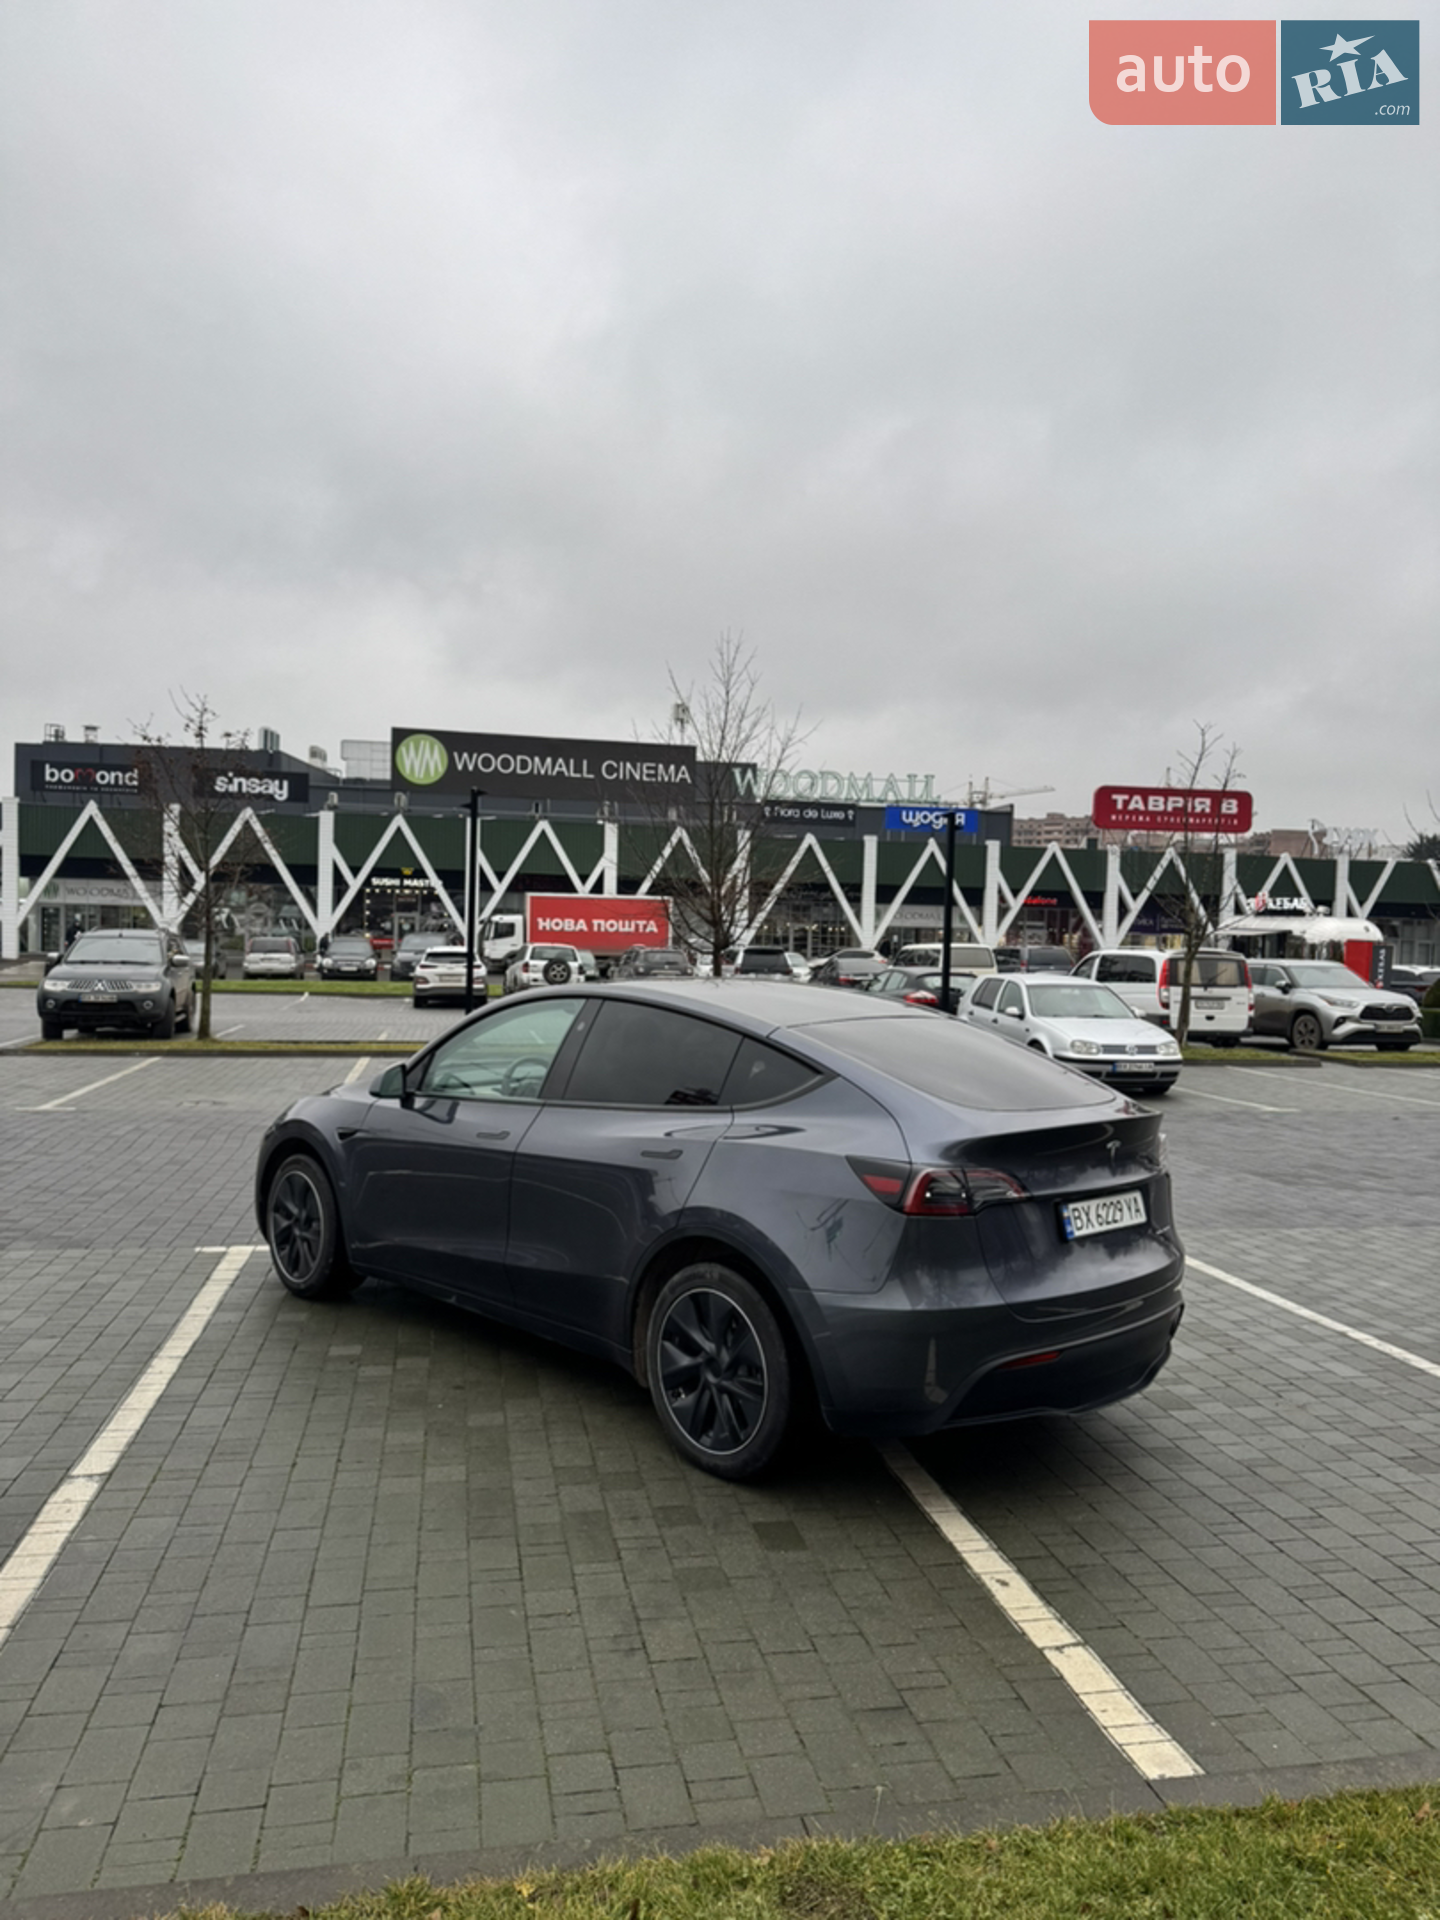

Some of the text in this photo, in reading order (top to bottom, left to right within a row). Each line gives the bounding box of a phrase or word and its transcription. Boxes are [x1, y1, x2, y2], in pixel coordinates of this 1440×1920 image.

[44, 763, 139, 787] bomond
[453, 751, 692, 784] WOODMALL CINEMA
[214, 771, 289, 801] sinsay
[732, 767, 941, 804] WOODMALL
[1111, 794, 1239, 814] ТАВРІЯ В
[537, 917, 658, 933] НОВА ПОШТА
[1071, 1196, 1143, 1231] BX 6229 YA
